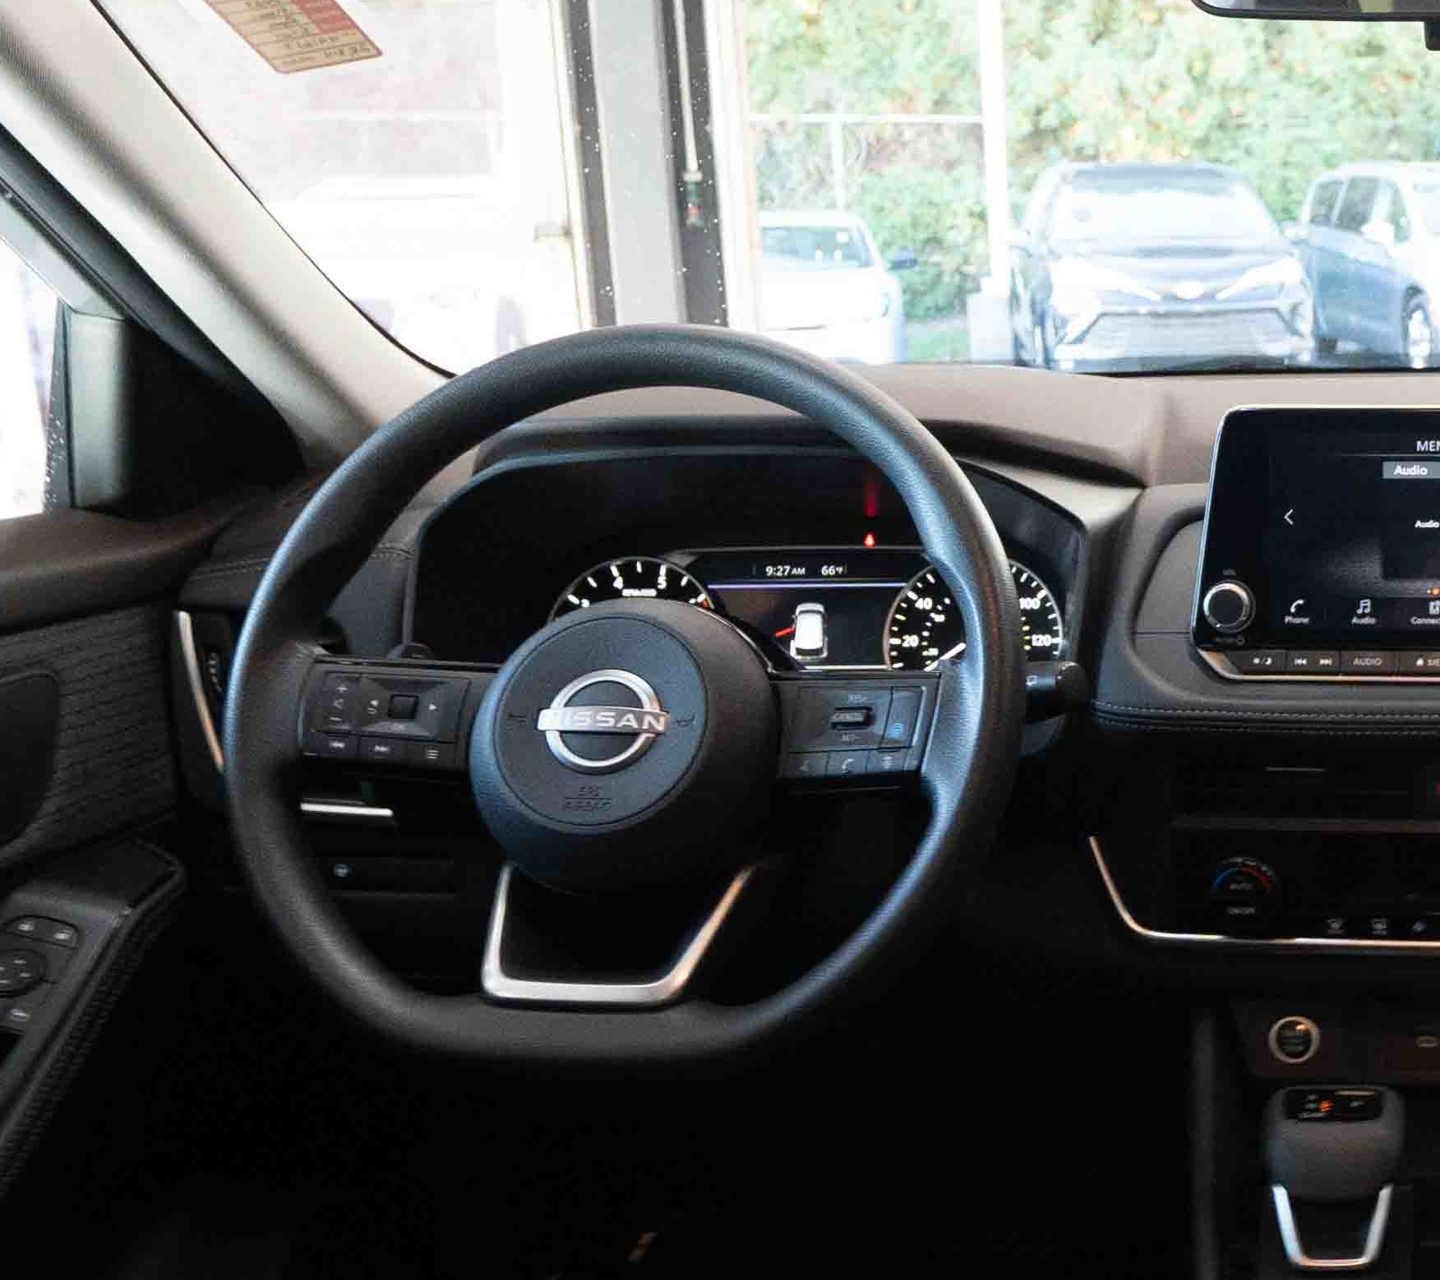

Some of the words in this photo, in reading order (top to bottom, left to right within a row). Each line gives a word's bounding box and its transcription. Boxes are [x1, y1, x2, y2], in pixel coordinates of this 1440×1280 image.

[1392, 463, 1429, 477] Audio
[1415, 520, 1440, 529] Audio
[914, 597, 933, 610] 40
[1019, 597, 1041, 610] 100
[1284, 616, 1310, 625] Phone
[1351, 616, 1377, 625] Audio
[902, 634, 920, 647] 20
[1031, 634, 1054, 647] 120
[1353, 657, 1383, 667] AUDIO
[542, 710, 667, 732] ISSAN
